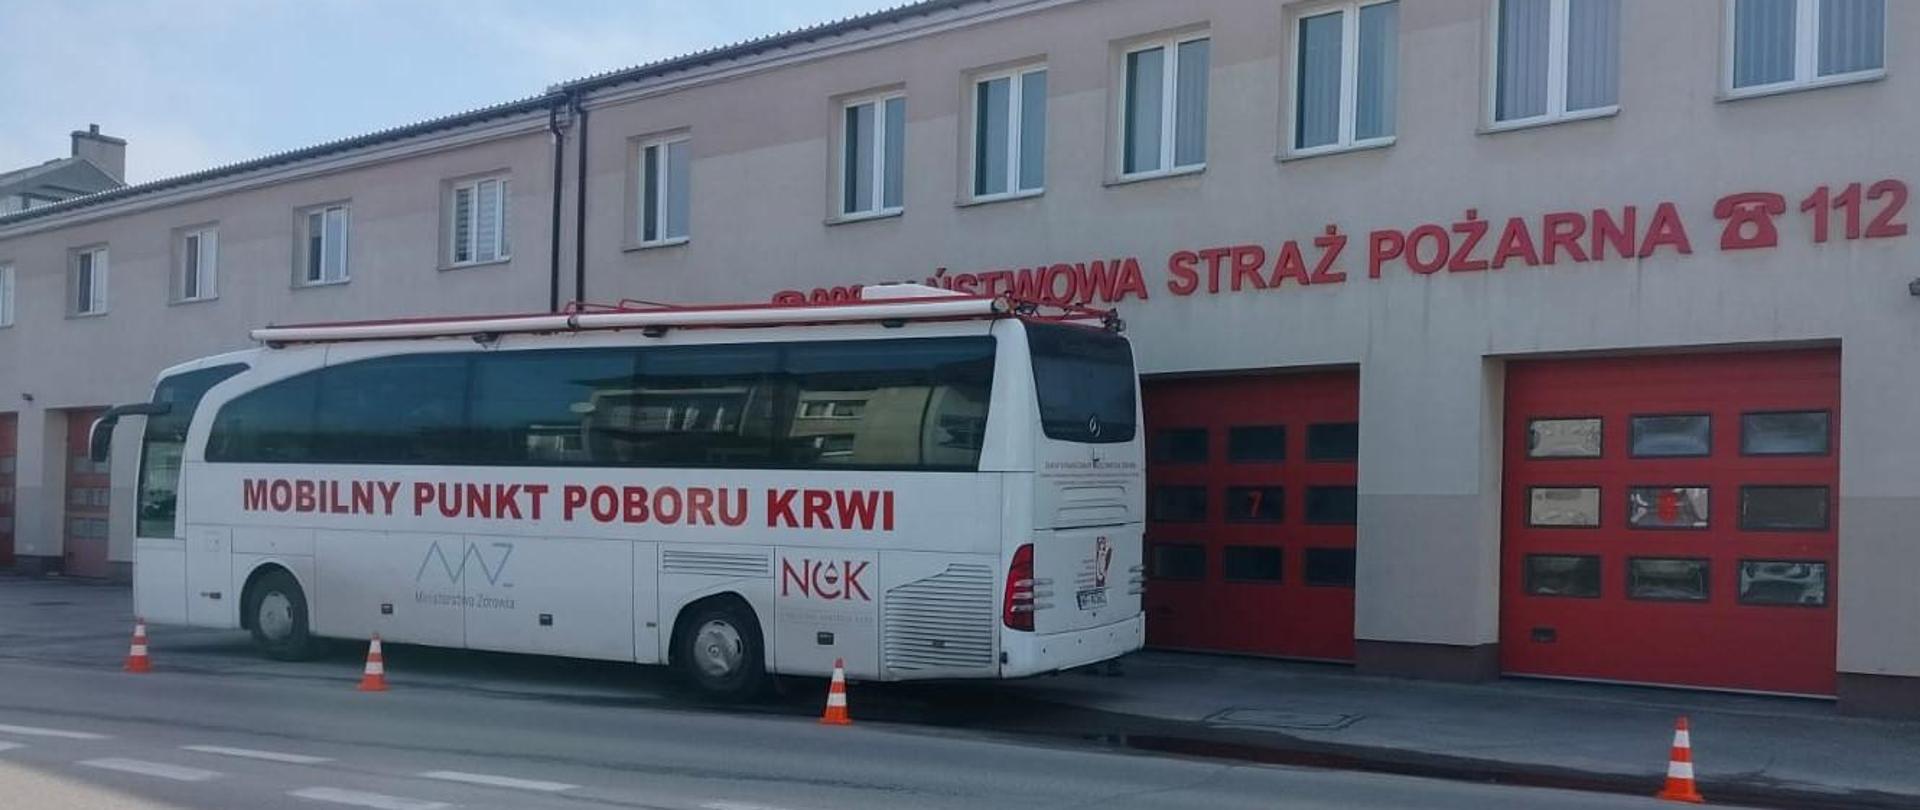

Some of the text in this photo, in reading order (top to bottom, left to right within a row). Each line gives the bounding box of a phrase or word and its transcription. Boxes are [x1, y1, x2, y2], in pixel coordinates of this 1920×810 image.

[1167, 224, 1347, 296] STRAŻ
[1369, 209, 1692, 278] POŻARNA
[1800, 179, 1908, 243] 112
[243, 479, 896, 531] MOBILNY PUNKT POBORU KRWI
